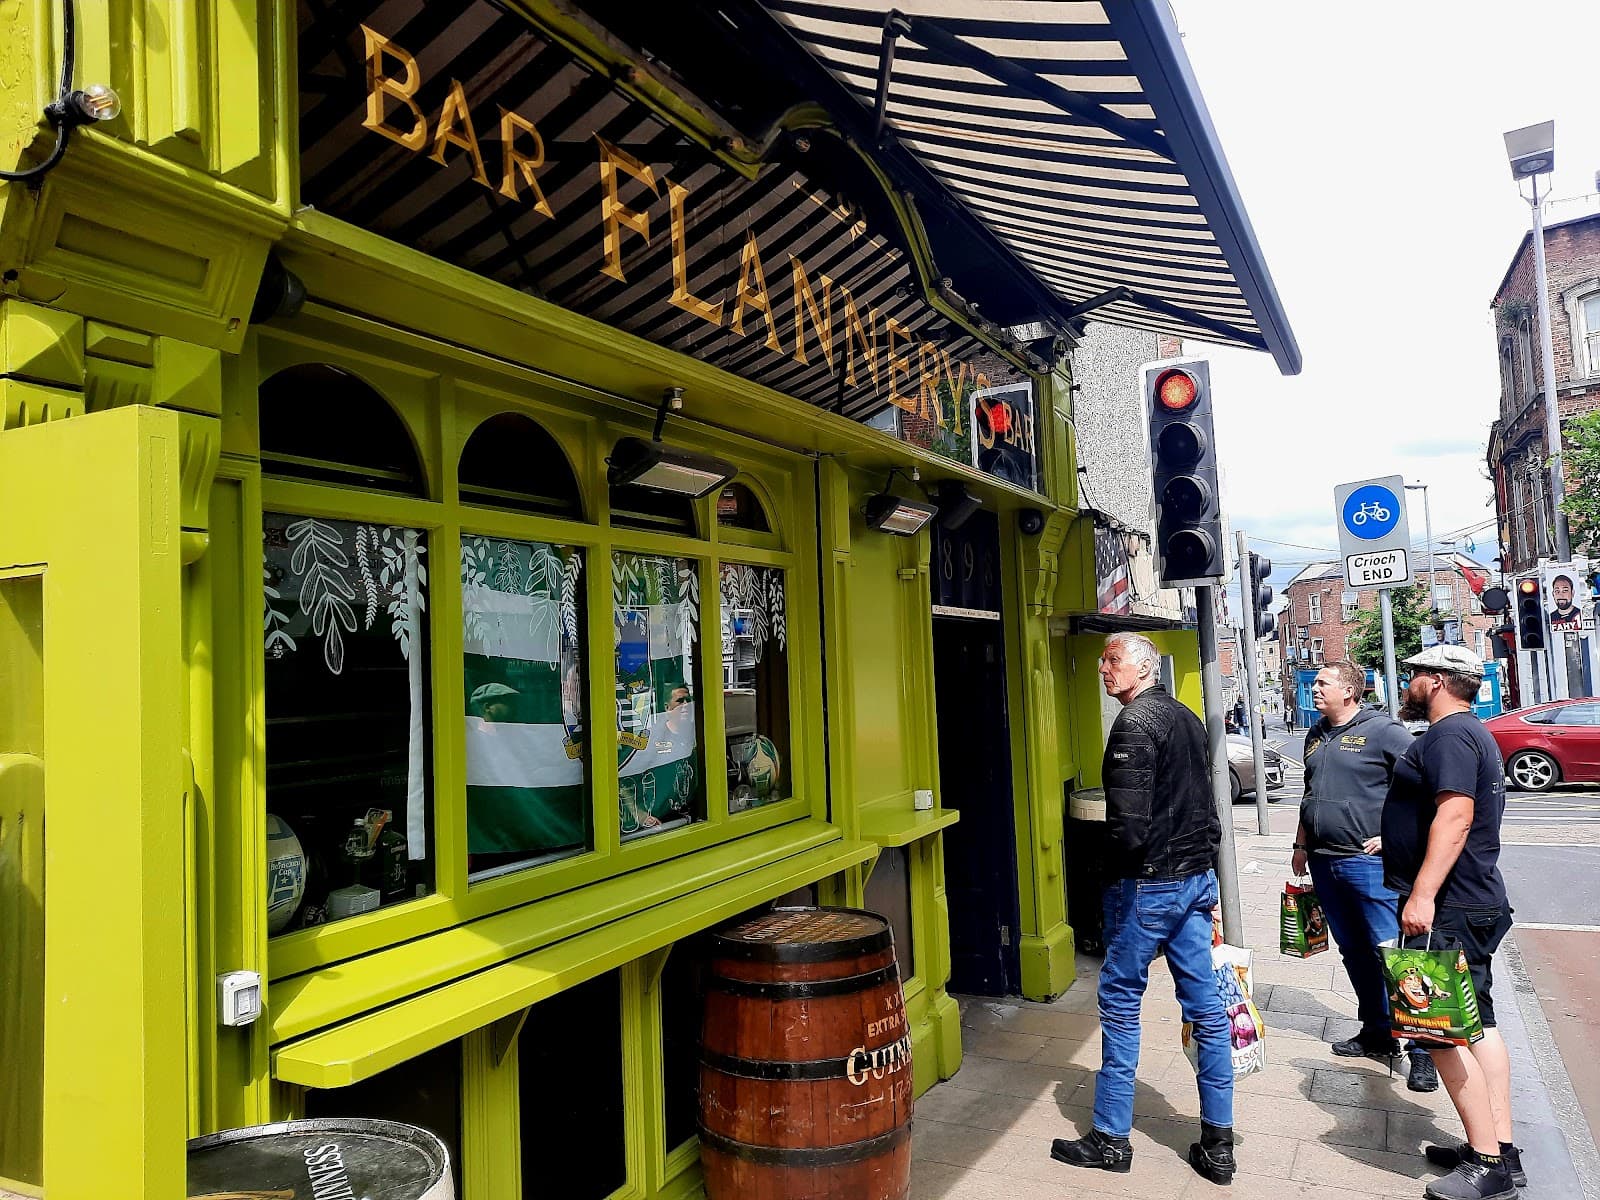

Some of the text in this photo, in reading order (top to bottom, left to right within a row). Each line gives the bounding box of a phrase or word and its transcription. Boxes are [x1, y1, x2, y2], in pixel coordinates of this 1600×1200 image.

[360, 23, 556, 220] BAR
[591, 129, 996, 450] FLANNERY'S
[1362, 567, 1393, 581] END
[1551, 621, 1577, 632] FAHY
[867, 1012, 901, 1038] EXTRA
[1231, 1045, 1260, 1066] TESCO
[1479, 1154, 1501, 1165] CAT
[303, 1143, 357, 1200] INNESS
